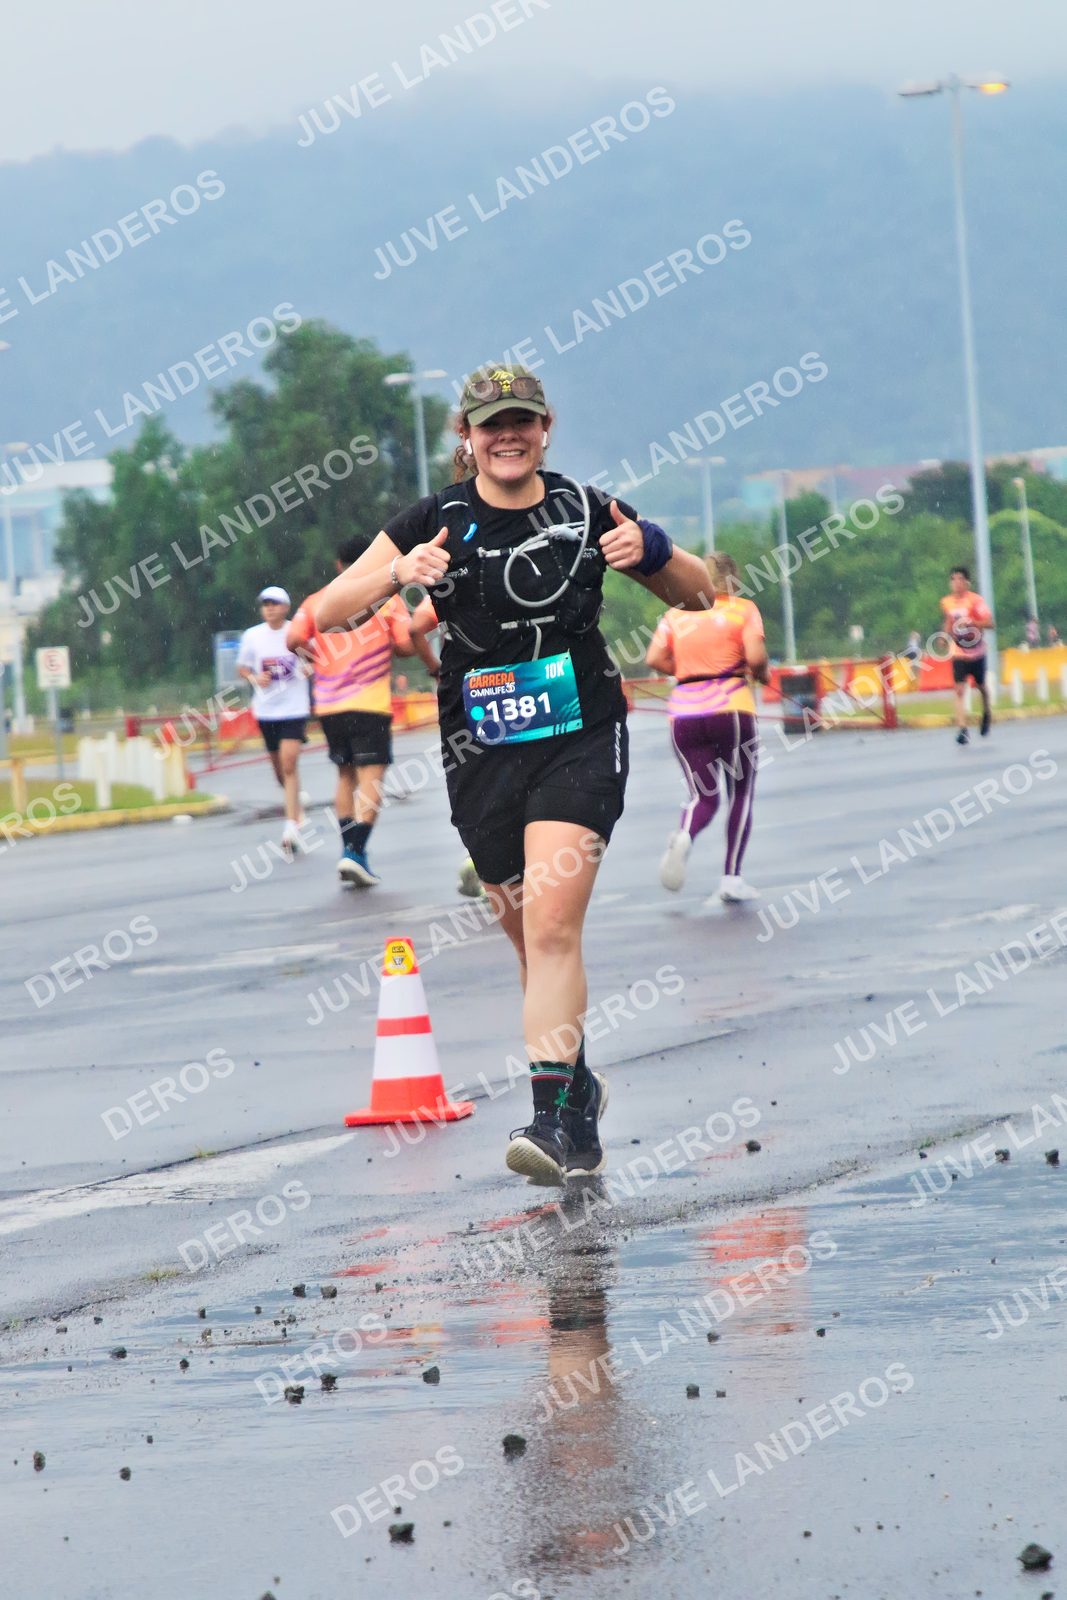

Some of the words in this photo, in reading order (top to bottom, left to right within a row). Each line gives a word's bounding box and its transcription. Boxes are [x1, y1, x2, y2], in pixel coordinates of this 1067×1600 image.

[544, 661, 565, 680] 10K
[469, 671, 515, 689] CARRERA
[470, 686, 505, 698] OMNILIFE
[486, 692, 551, 723] 1381
